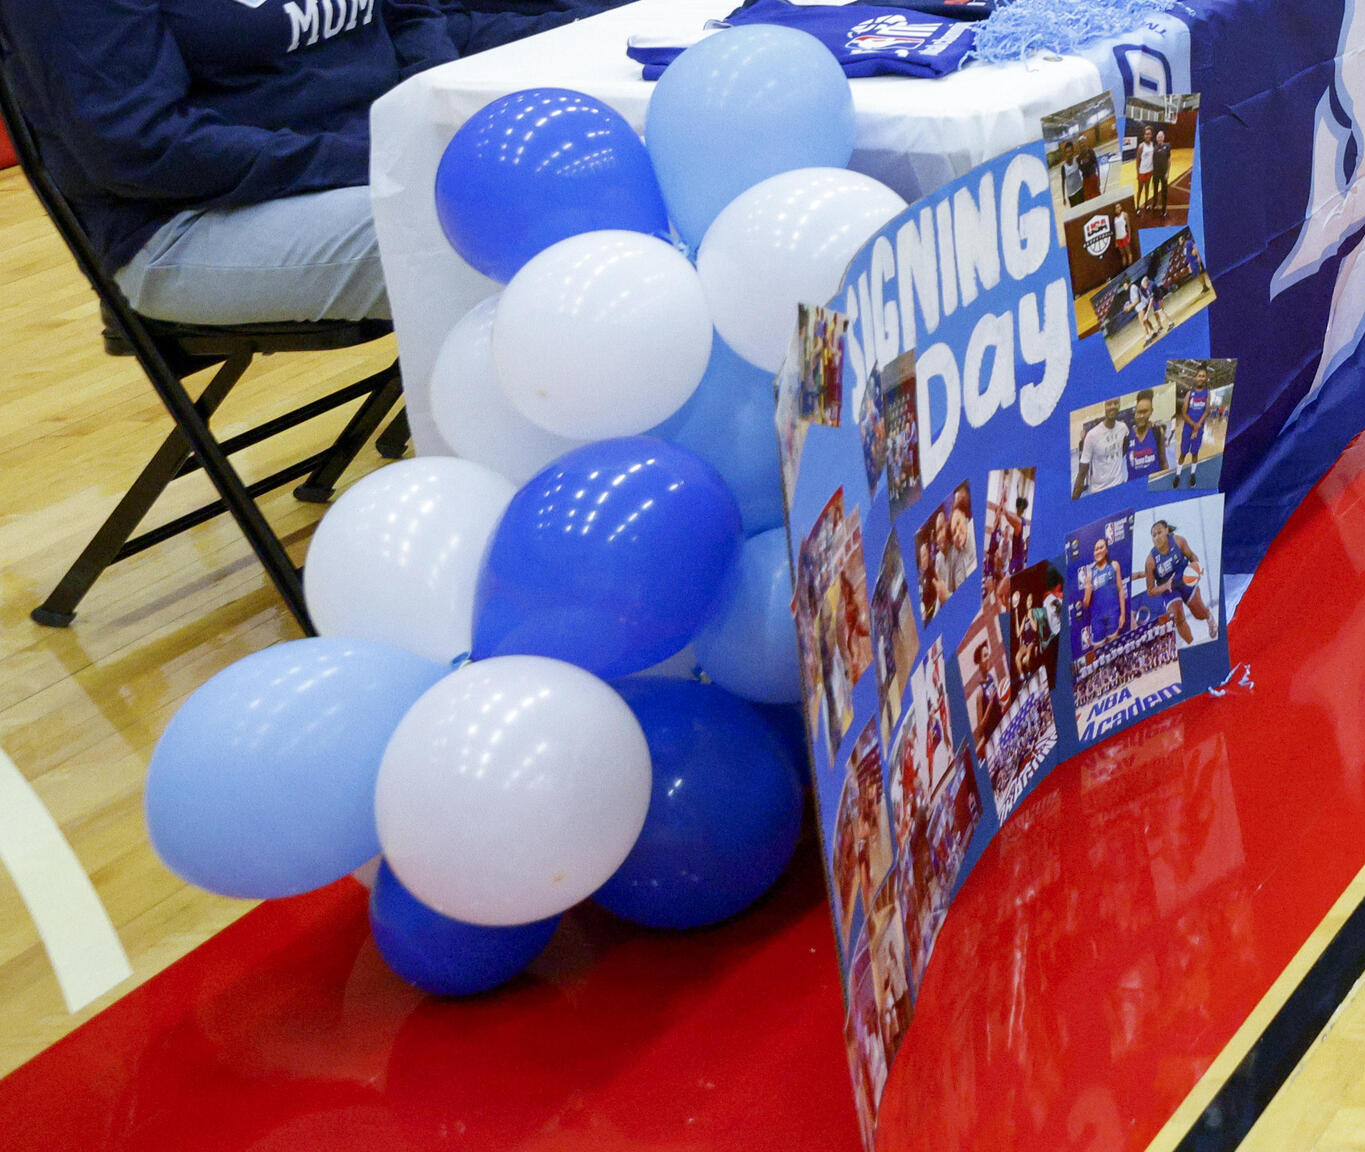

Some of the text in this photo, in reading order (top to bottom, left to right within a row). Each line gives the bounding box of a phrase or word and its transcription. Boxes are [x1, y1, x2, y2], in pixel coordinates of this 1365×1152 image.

[846, 153, 1051, 426] SIGNING
[1079, 682, 1183, 744] Academ
[1086, 686, 1133, 723] NBA
